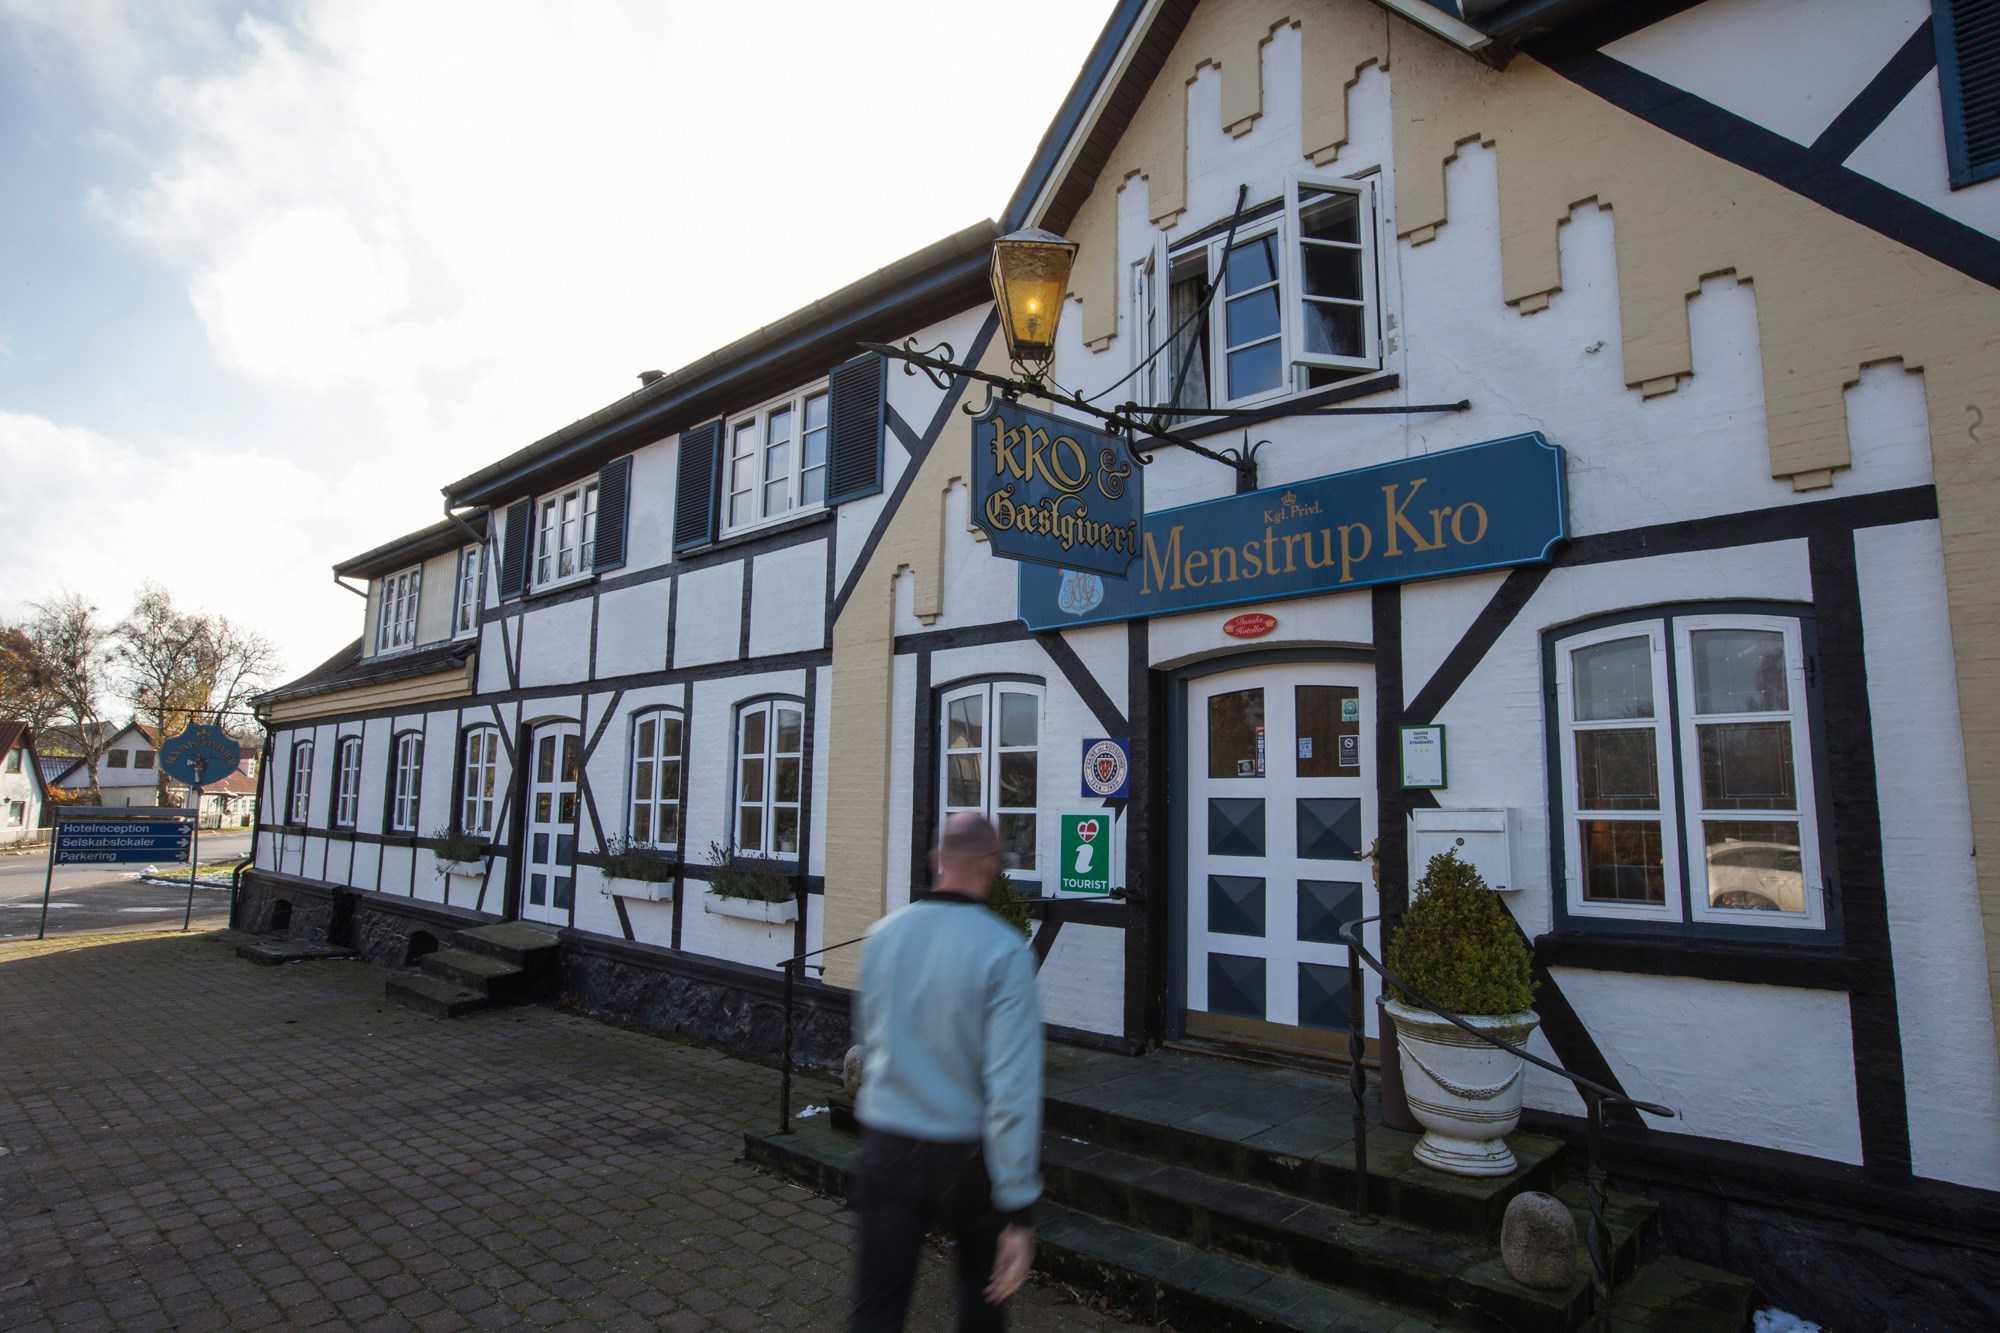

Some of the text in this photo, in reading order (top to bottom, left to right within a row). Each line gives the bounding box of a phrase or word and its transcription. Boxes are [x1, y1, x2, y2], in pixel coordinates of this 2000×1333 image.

[991, 416, 1131, 500] KRO &
[1139, 522, 1372, 595] Menstrup
[1381, 478, 1489, 557] Kro
[63, 823, 150, 835] Hotelreception
[62, 837, 155, 848] Selskabslokaler
[59, 851, 117, 862] Parkering
[1062, 878, 1108, 890] TOURIST
